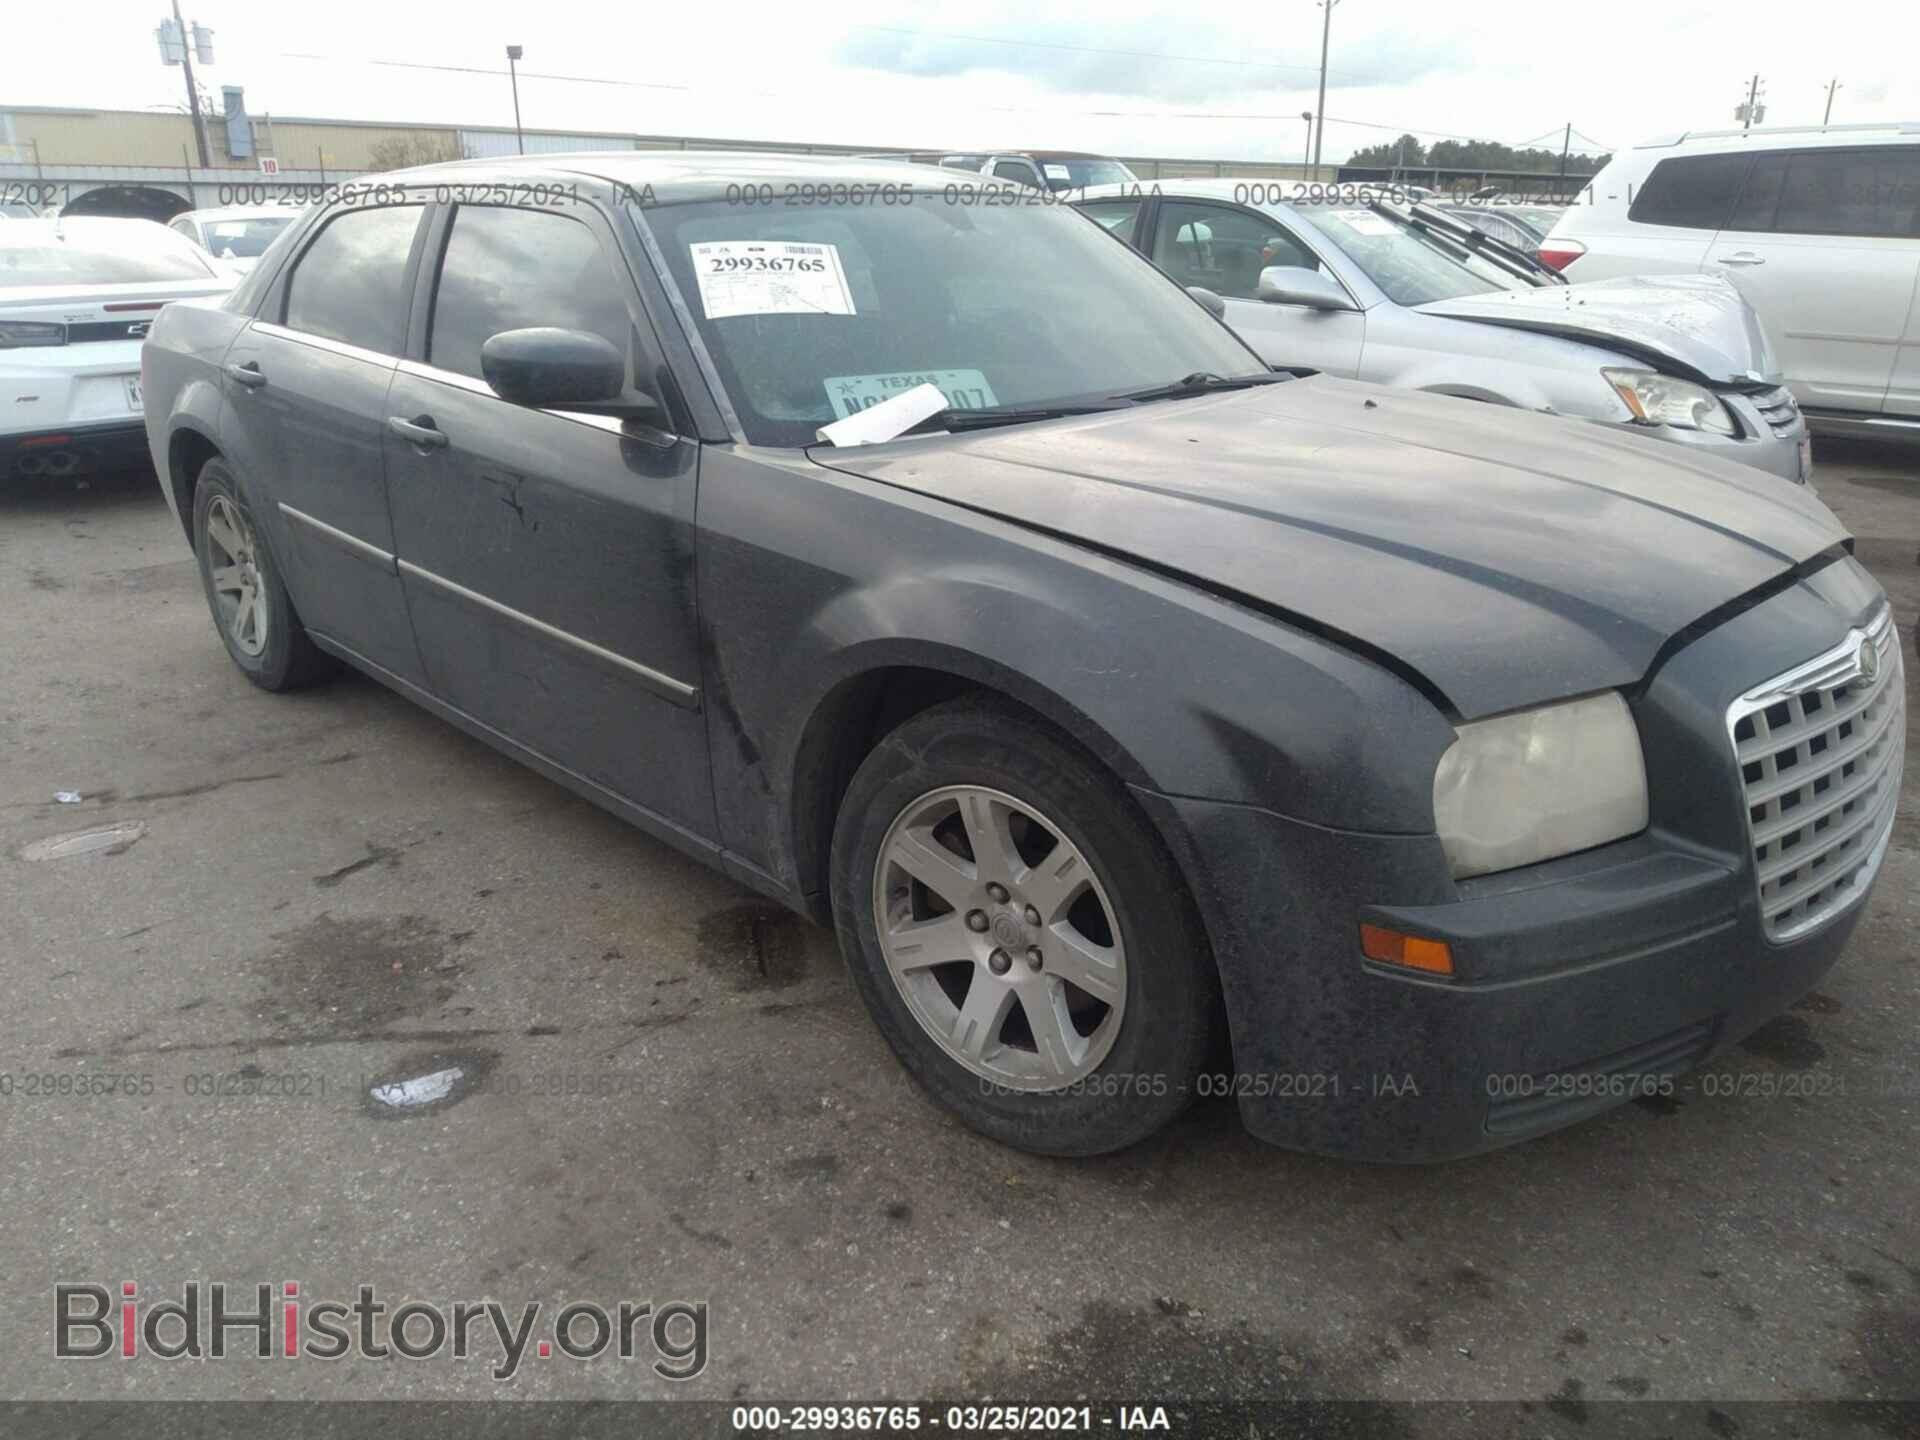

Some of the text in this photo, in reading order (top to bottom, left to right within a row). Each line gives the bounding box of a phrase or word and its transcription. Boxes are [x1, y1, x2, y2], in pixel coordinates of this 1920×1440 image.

[262, 160, 276, 173] 10
[710, 257, 825, 272] 29936765
[876, 374, 940, 389] TEXAS
